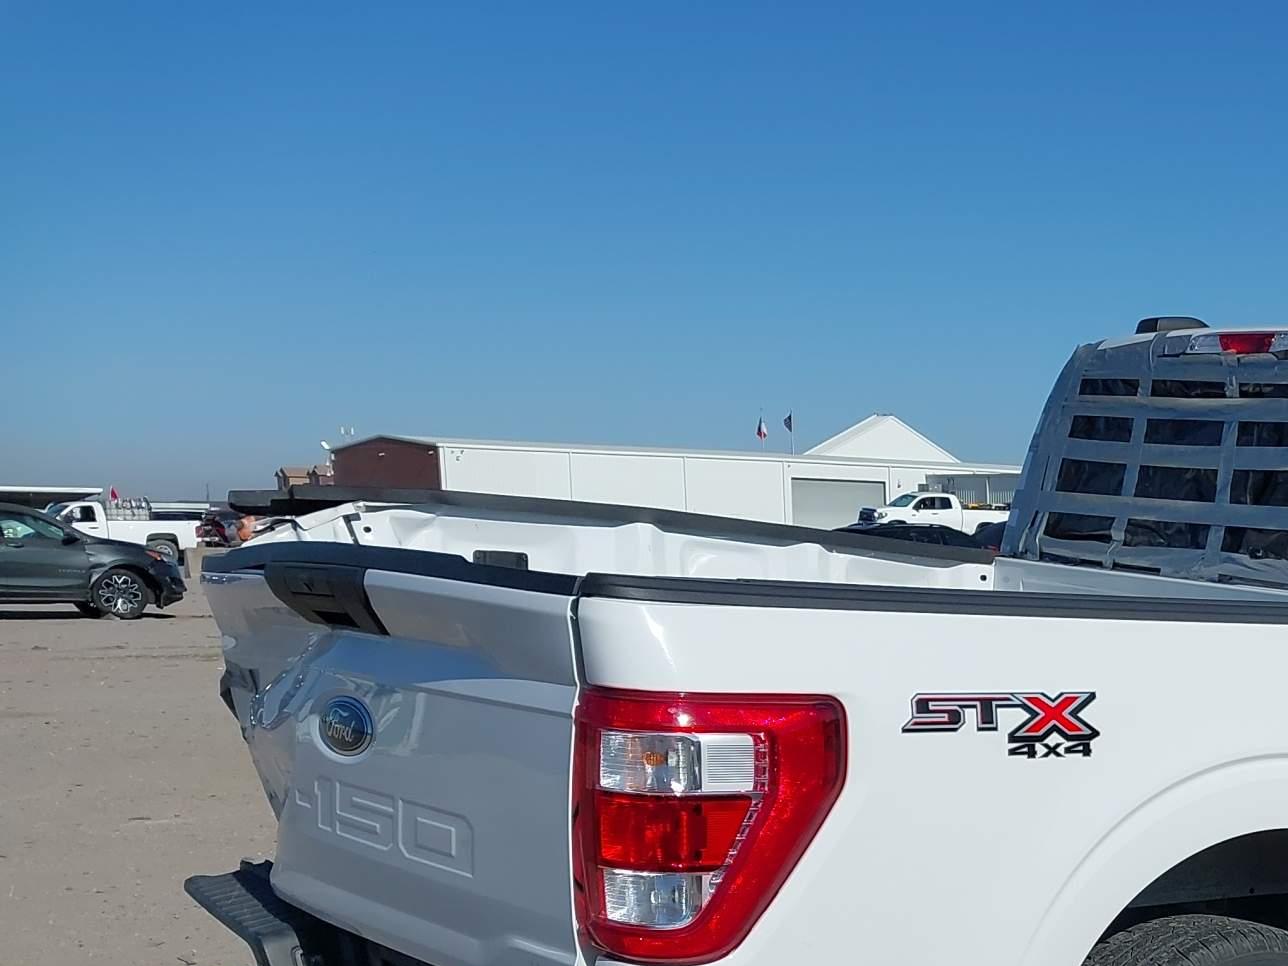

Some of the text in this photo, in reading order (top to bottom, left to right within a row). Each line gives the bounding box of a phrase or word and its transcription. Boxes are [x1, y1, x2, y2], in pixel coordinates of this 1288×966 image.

[325, 707, 356, 743] Ford
[902, 691, 1100, 743] STX
[1007, 741, 1093, 759] 4x4
